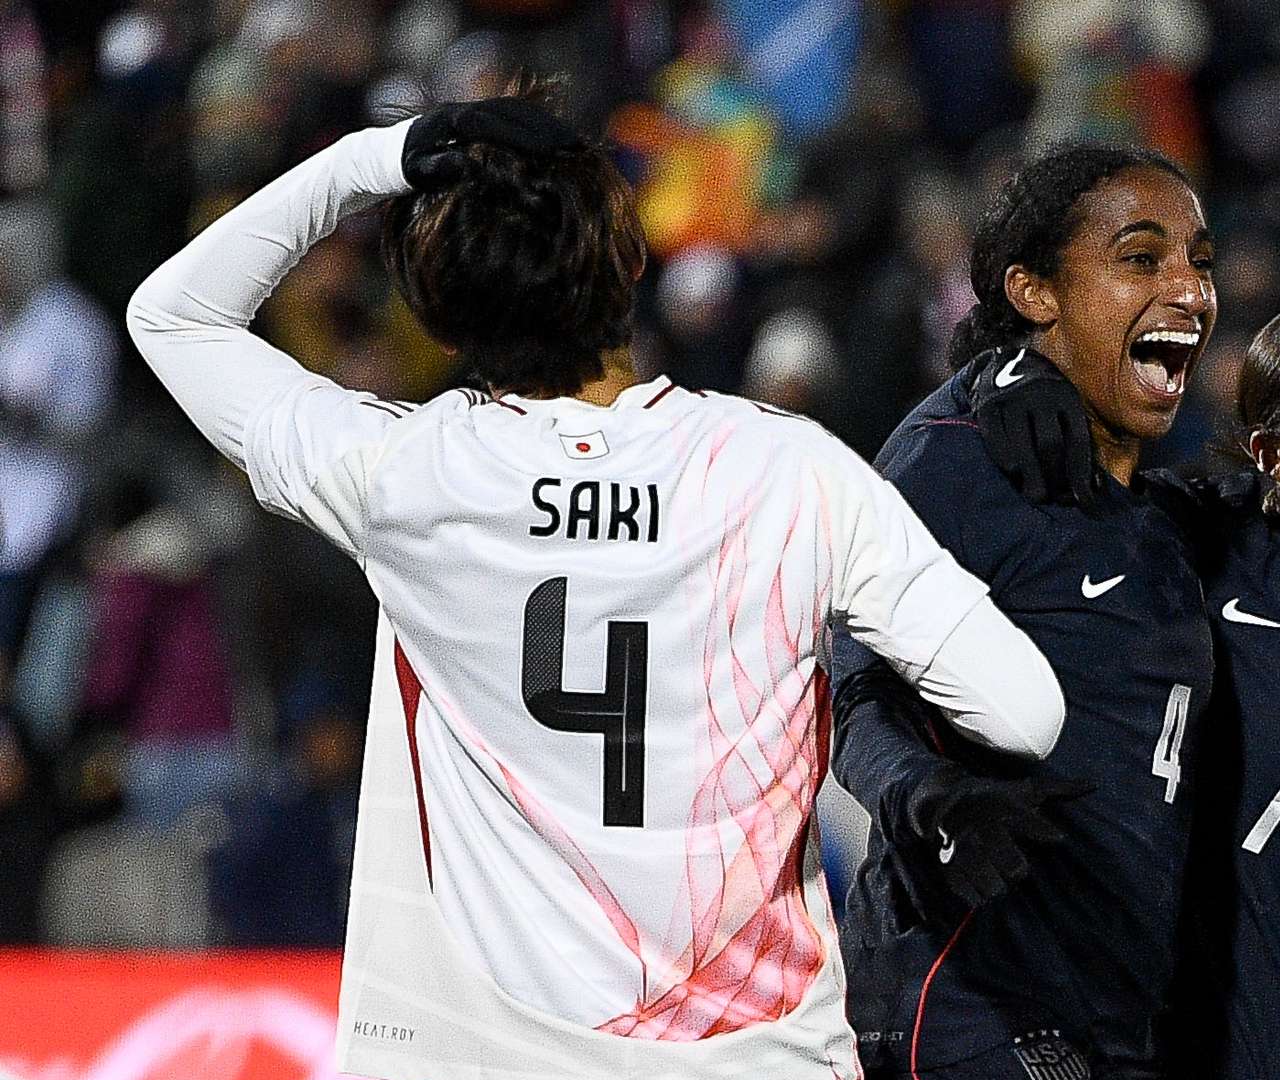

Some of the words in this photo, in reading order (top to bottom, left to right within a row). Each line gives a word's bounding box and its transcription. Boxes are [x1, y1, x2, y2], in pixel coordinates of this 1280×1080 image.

[529, 477, 660, 543] SAKI
[521, 576, 649, 828] 4
[1152, 684, 1192, 804] 4
[354, 1021, 415, 1041] HEAT.RDY
